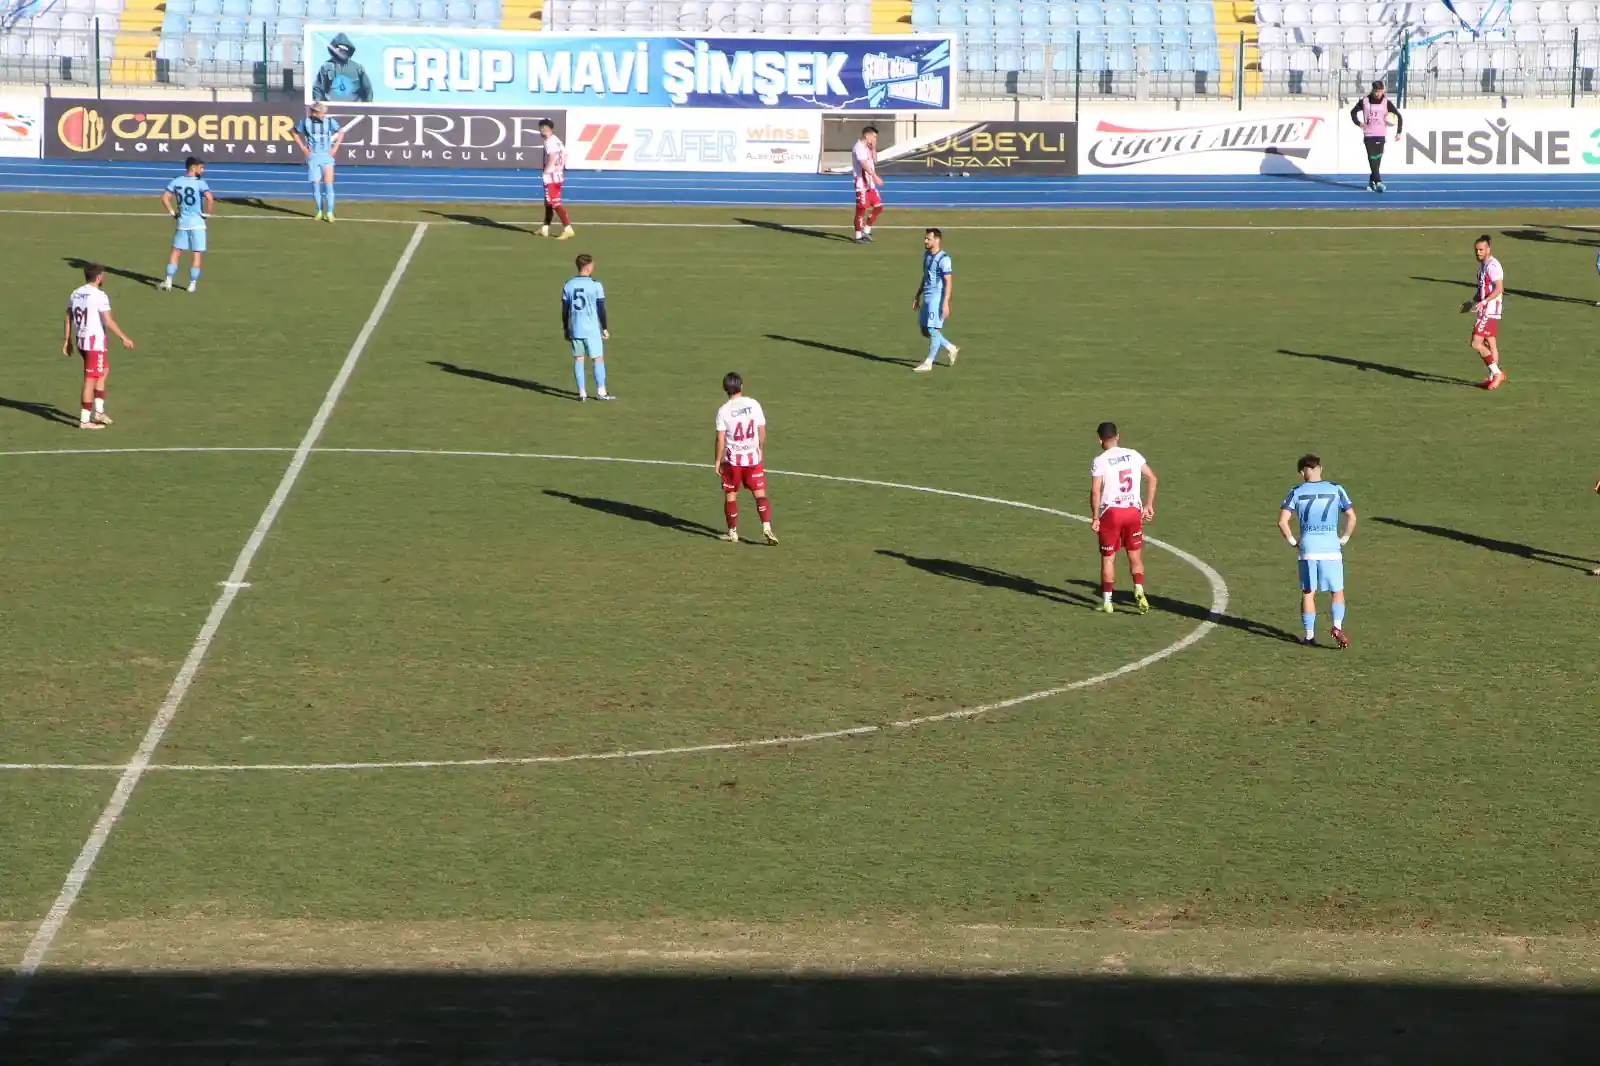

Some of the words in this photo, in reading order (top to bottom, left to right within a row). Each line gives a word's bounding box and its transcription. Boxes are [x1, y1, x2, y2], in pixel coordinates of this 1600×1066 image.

[384, 47, 514, 92] GRUP
[527, 41, 649, 94] MAVİ
[662, 39, 850, 106] ŞİMŞEK
[326, 114, 552, 148] ZERDE
[746, 124, 810, 141] winsa
[1208, 116, 1325, 148] AHMET
[114, 141, 293, 154] LOKANTASI
[348, 149, 524, 161] KUYUMCULUK
[634, 128, 737, 163] ZAFER
[174, 185, 196, 206] 58
[573, 287, 586, 311] 5
[74, 306, 88, 326] 61
[733, 419, 755, 441] 44
[1118, 468, 1133, 493] 5
[1298, 494, 1336, 523] 77
